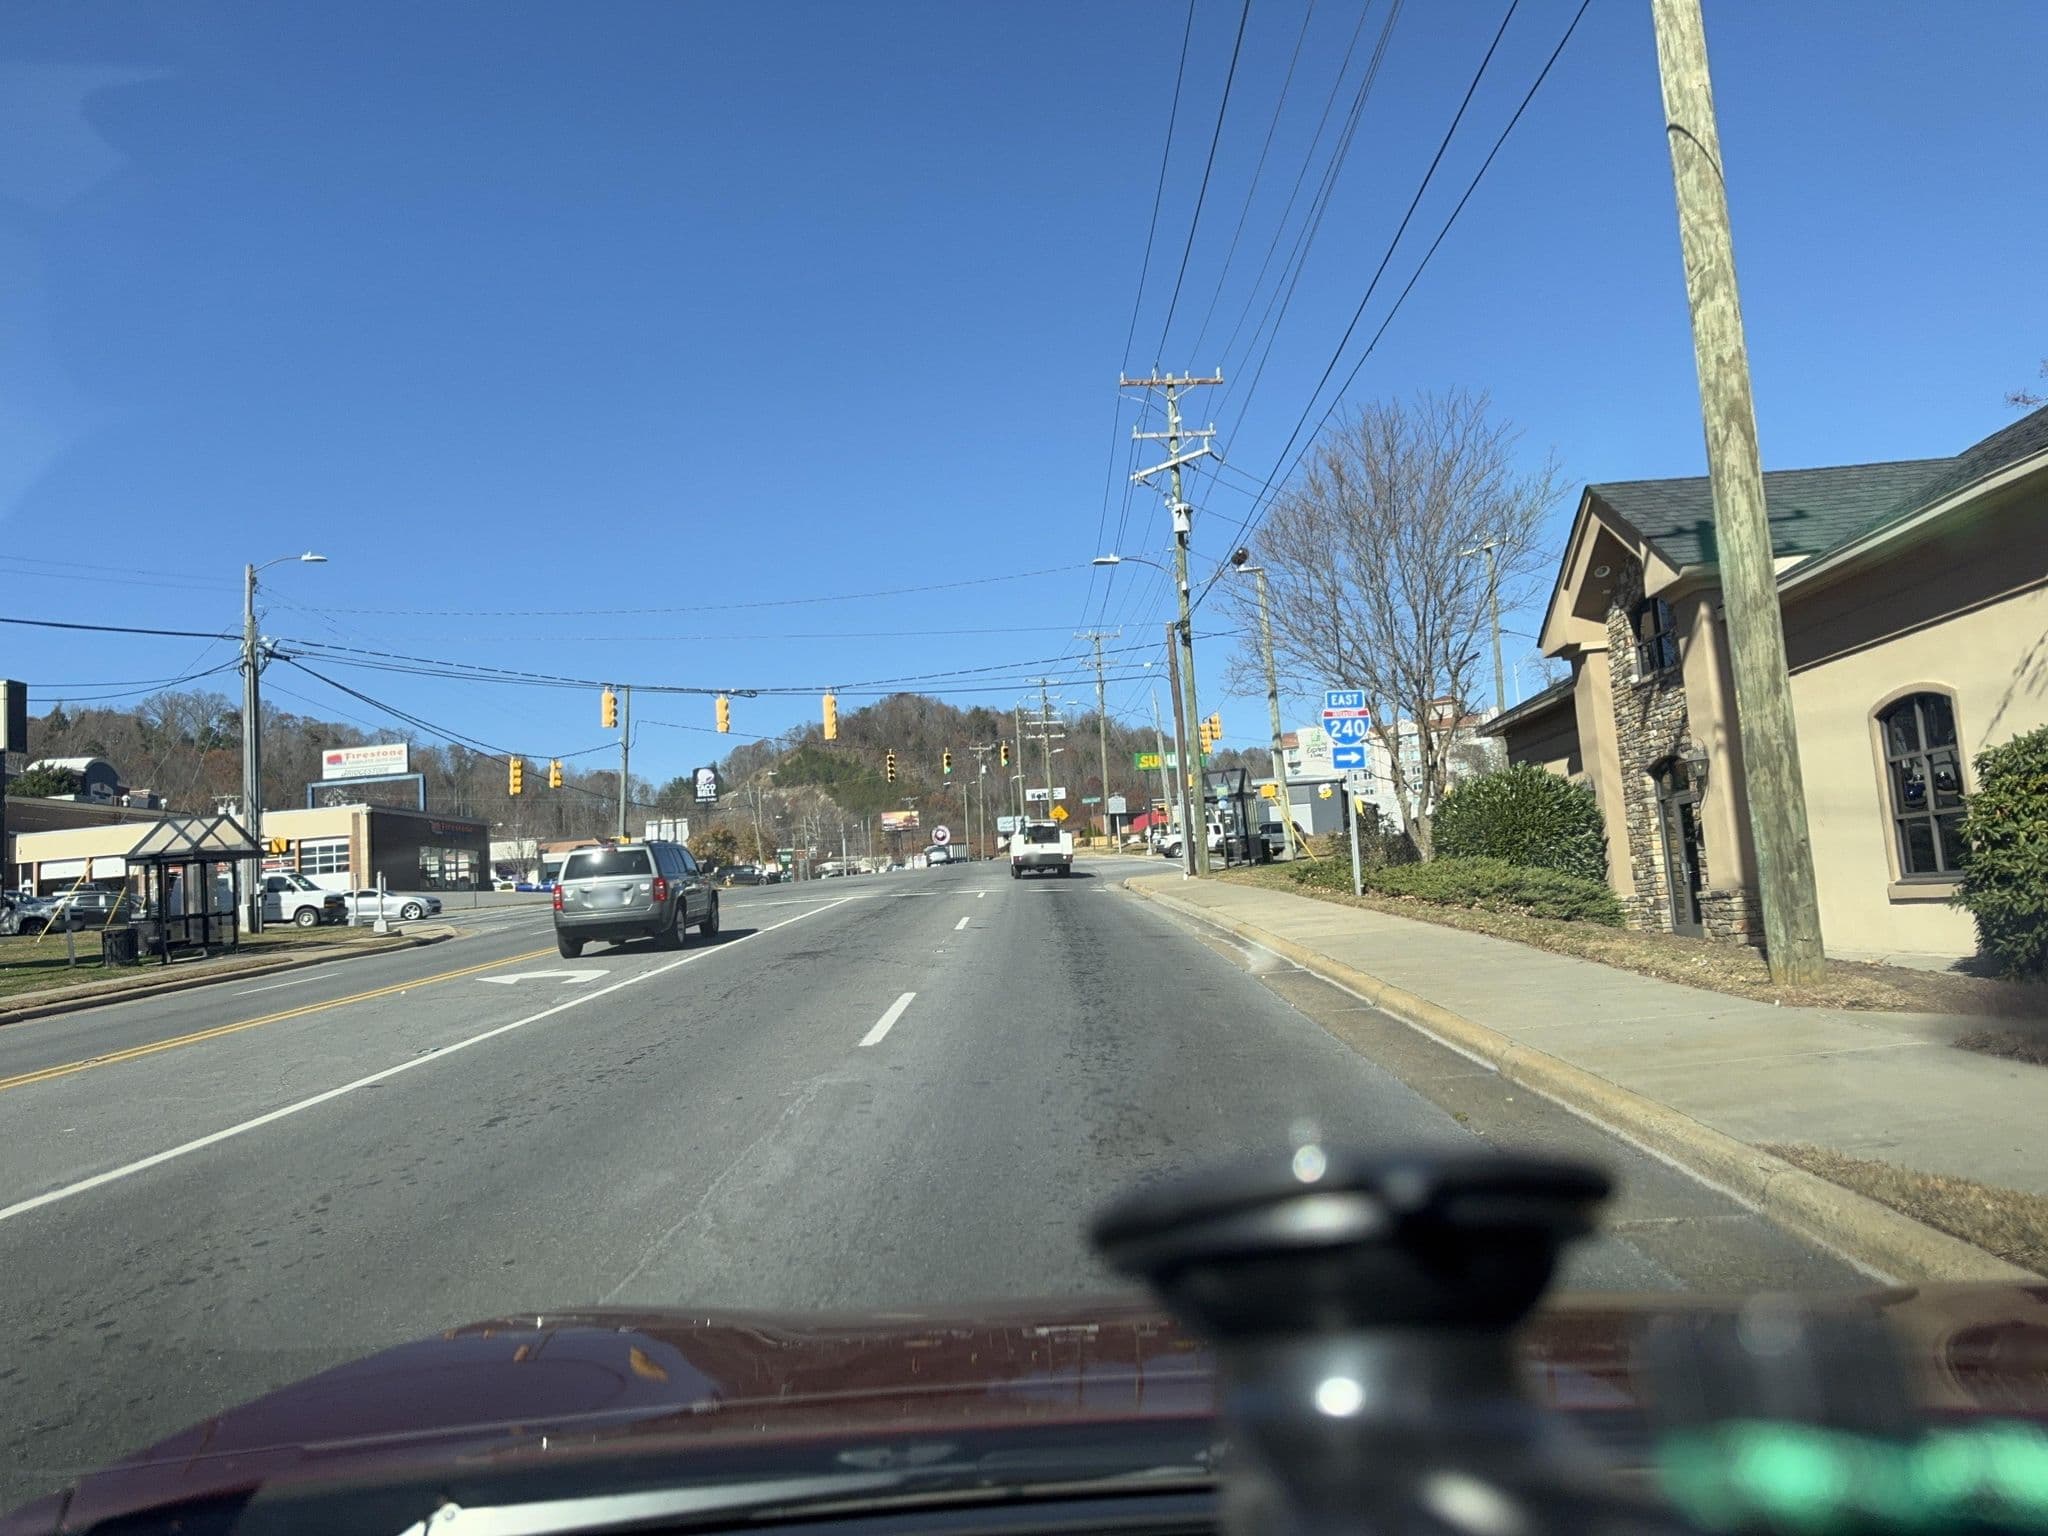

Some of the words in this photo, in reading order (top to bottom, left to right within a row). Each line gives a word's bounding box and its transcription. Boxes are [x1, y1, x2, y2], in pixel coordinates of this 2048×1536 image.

[1331, 694, 1358, 706] EAST
[1330, 719, 1365, 738] 240
[344, 749, 403, 760] Firestone
[697, 789, 716, 797] BELL
